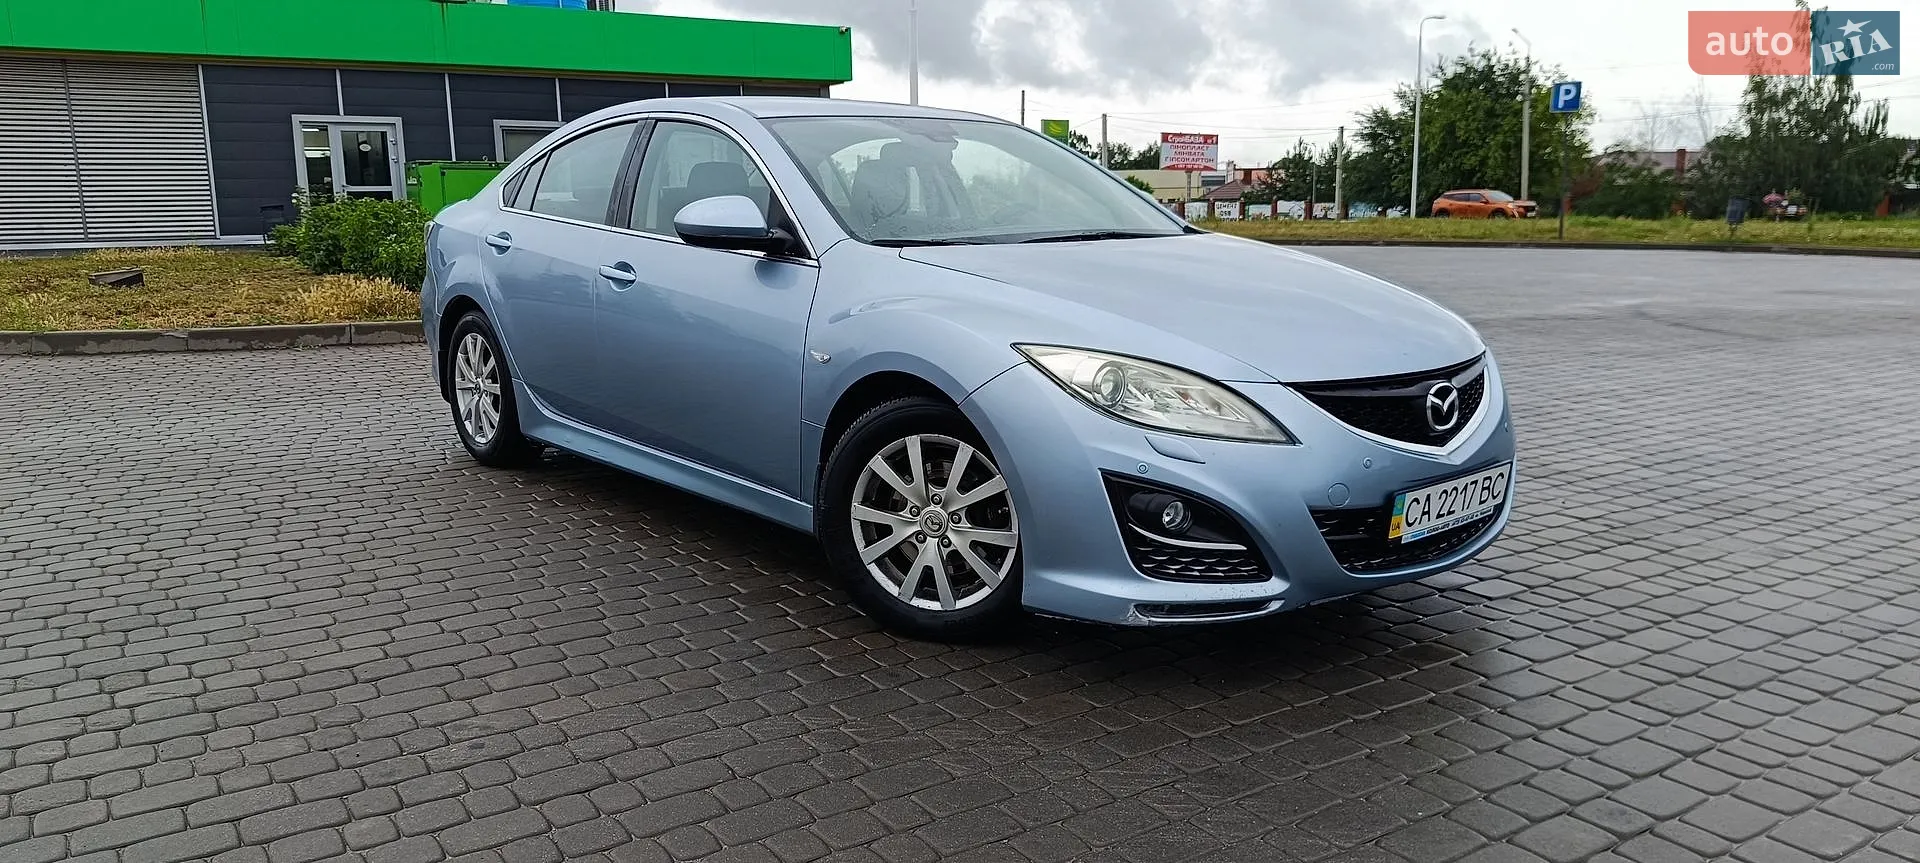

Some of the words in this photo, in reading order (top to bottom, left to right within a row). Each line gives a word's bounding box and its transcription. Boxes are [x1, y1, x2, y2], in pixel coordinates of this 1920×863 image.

[1558, 84, 1577, 109] P
[1405, 493, 1431, 527] CA
[1436, 480, 1478, 519] 2217
[1479, 472, 1504, 505] BC
